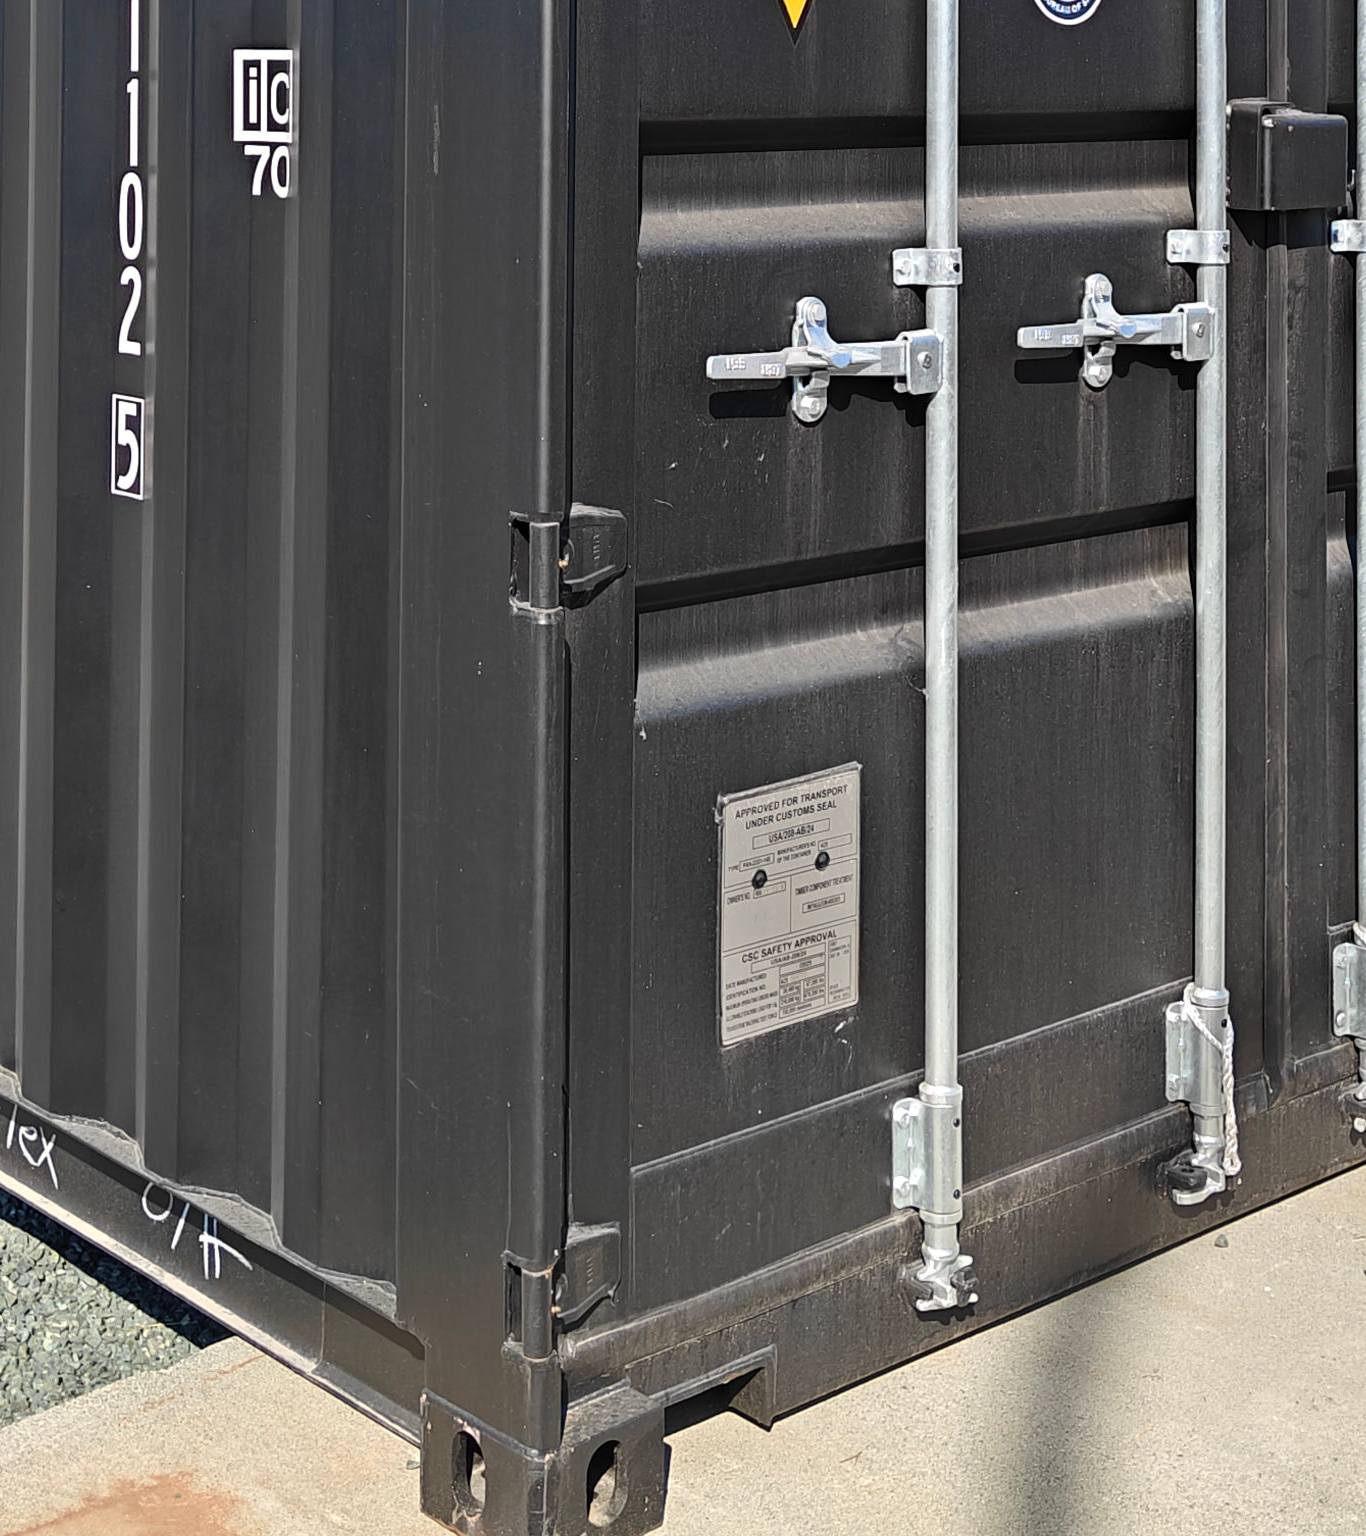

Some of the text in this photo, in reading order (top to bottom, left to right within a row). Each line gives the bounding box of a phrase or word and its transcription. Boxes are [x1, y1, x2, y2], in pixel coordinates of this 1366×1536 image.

[1071, 2, 1082, 14] OF
[243, 144, 291, 199] 70
[115, 398, 142, 493] 5
[734, 784, 848, 820] APPROVED FOR TRANSPORT
[745, 799, 838, 830] UNDER CUSTOMS SEAL
[741, 929, 838, 964] CSC SAFETY APPROVAL
